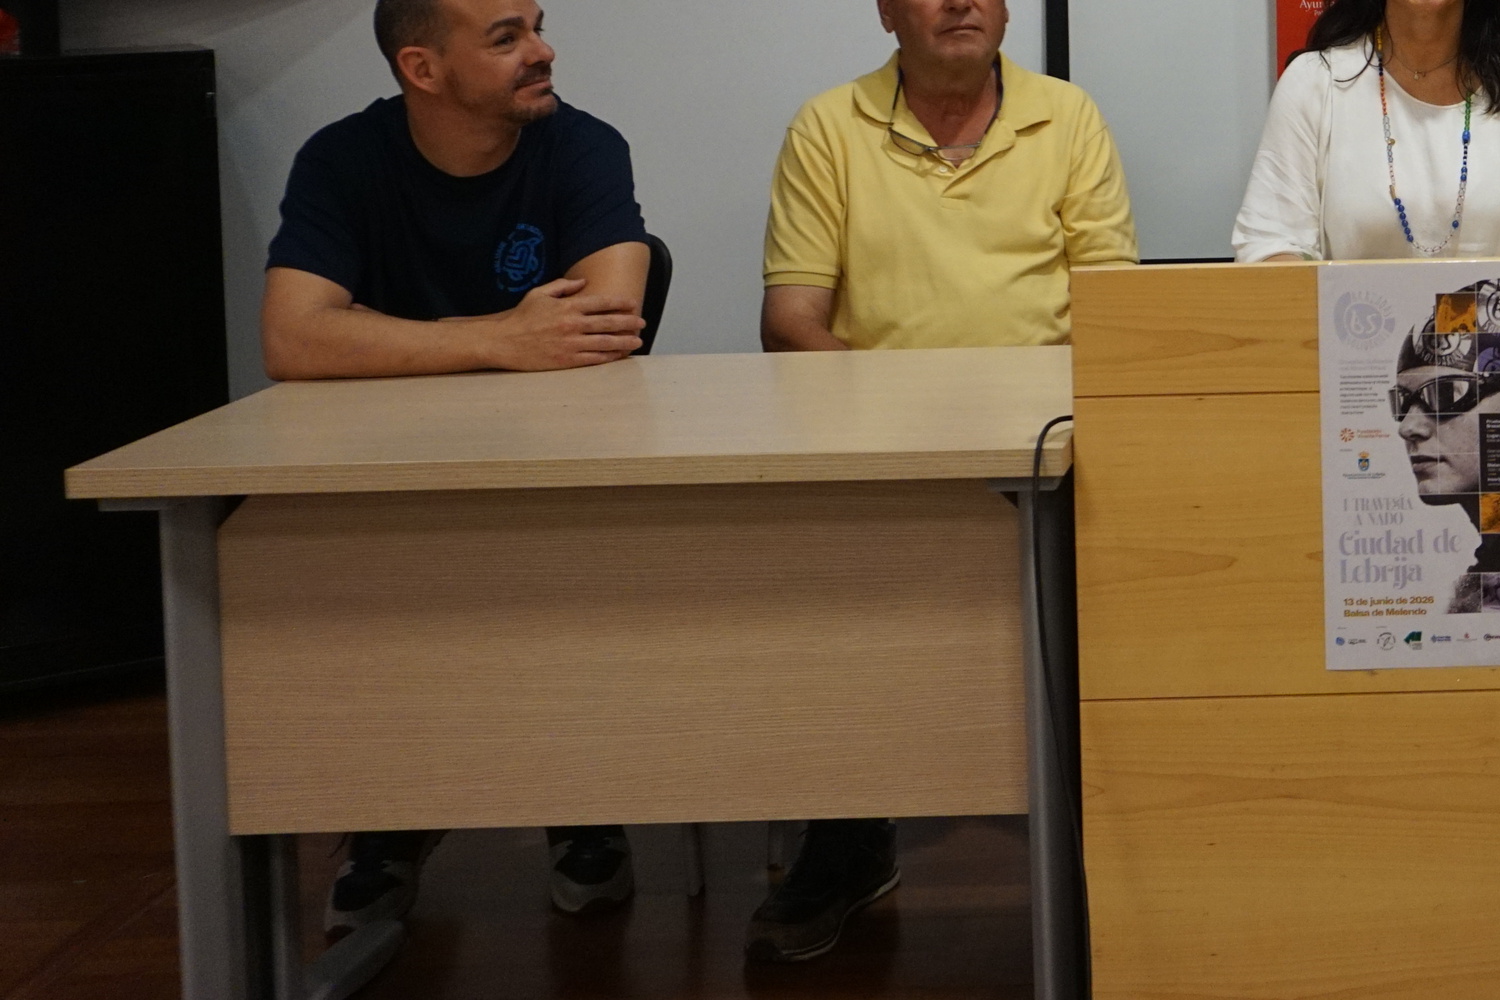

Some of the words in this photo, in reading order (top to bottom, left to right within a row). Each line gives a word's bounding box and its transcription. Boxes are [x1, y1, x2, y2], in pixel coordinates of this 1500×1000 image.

[1368, 512, 1404, 526] NADO
[1339, 529, 1424, 556] Ciudad
[1433, 528, 1462, 554] de
[1340, 556, 1424, 590] Lebrija
[1343, 598, 1354, 606] 13
[1356, 597, 1368, 606] de
[1369, 596, 1394, 607] junio
[1395, 596, 1408, 605] de
[1343, 609, 1370, 618] Balsa
[1371, 609, 1384, 617] de
